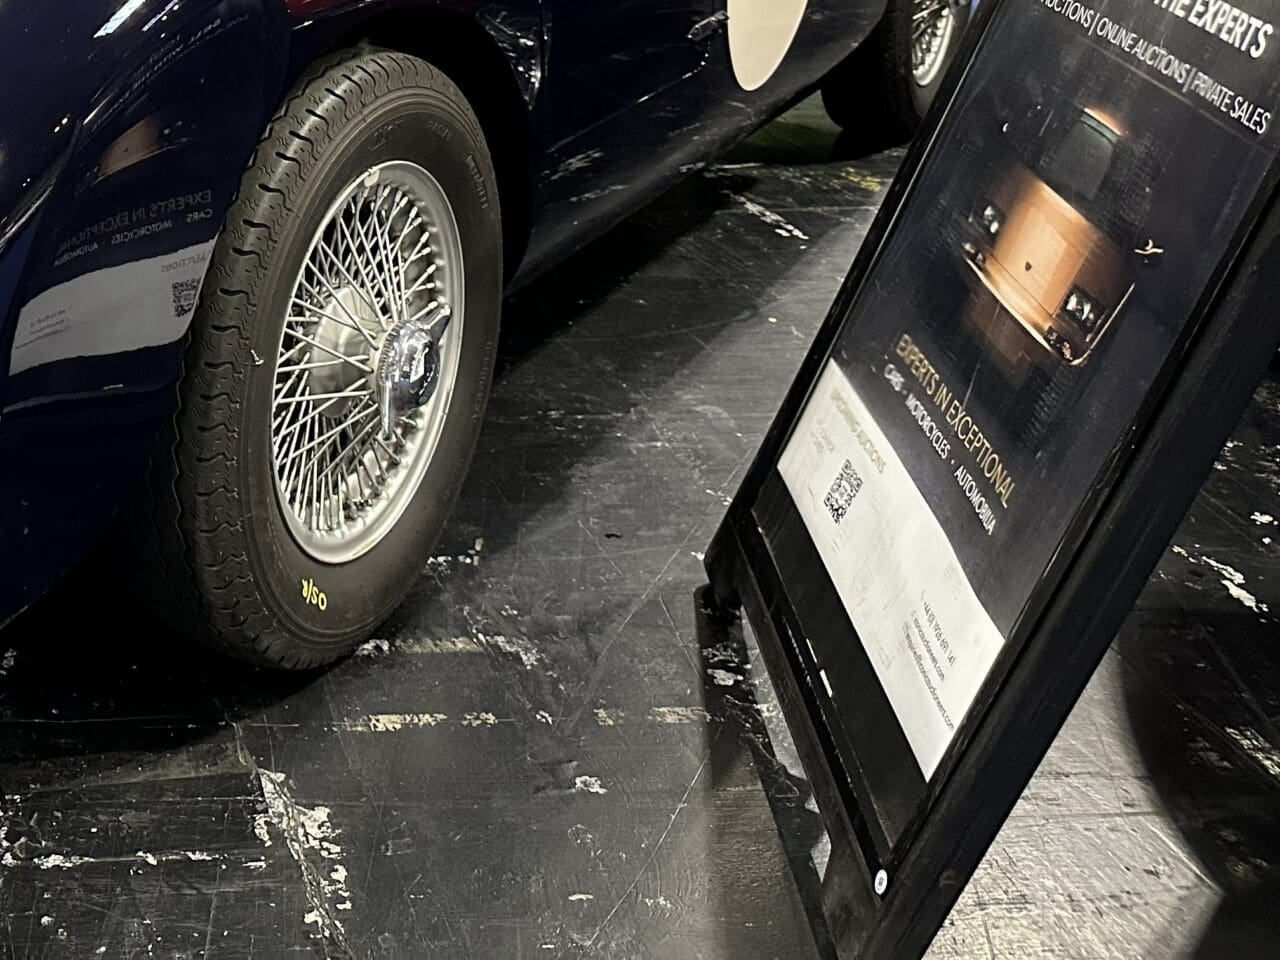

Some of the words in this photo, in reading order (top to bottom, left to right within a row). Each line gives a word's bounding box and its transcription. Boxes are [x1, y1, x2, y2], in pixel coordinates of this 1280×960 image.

[1096, 17, 1137, 53] ONLINE
[1131, 38, 1190, 85] AUCTIONS
[1190, 71, 1235, 112] PRIVATE
[1230, 95, 1272, 135] SALES
[896, 333, 940, 395] EXPERTS
[933, 382, 953, 412] IN
[945, 399, 1016, 509] EXCEPTIONAL
[904, 392, 952, 460] MOTORCYCLES
[953, 464, 997, 536] AUTOMOBILIA
